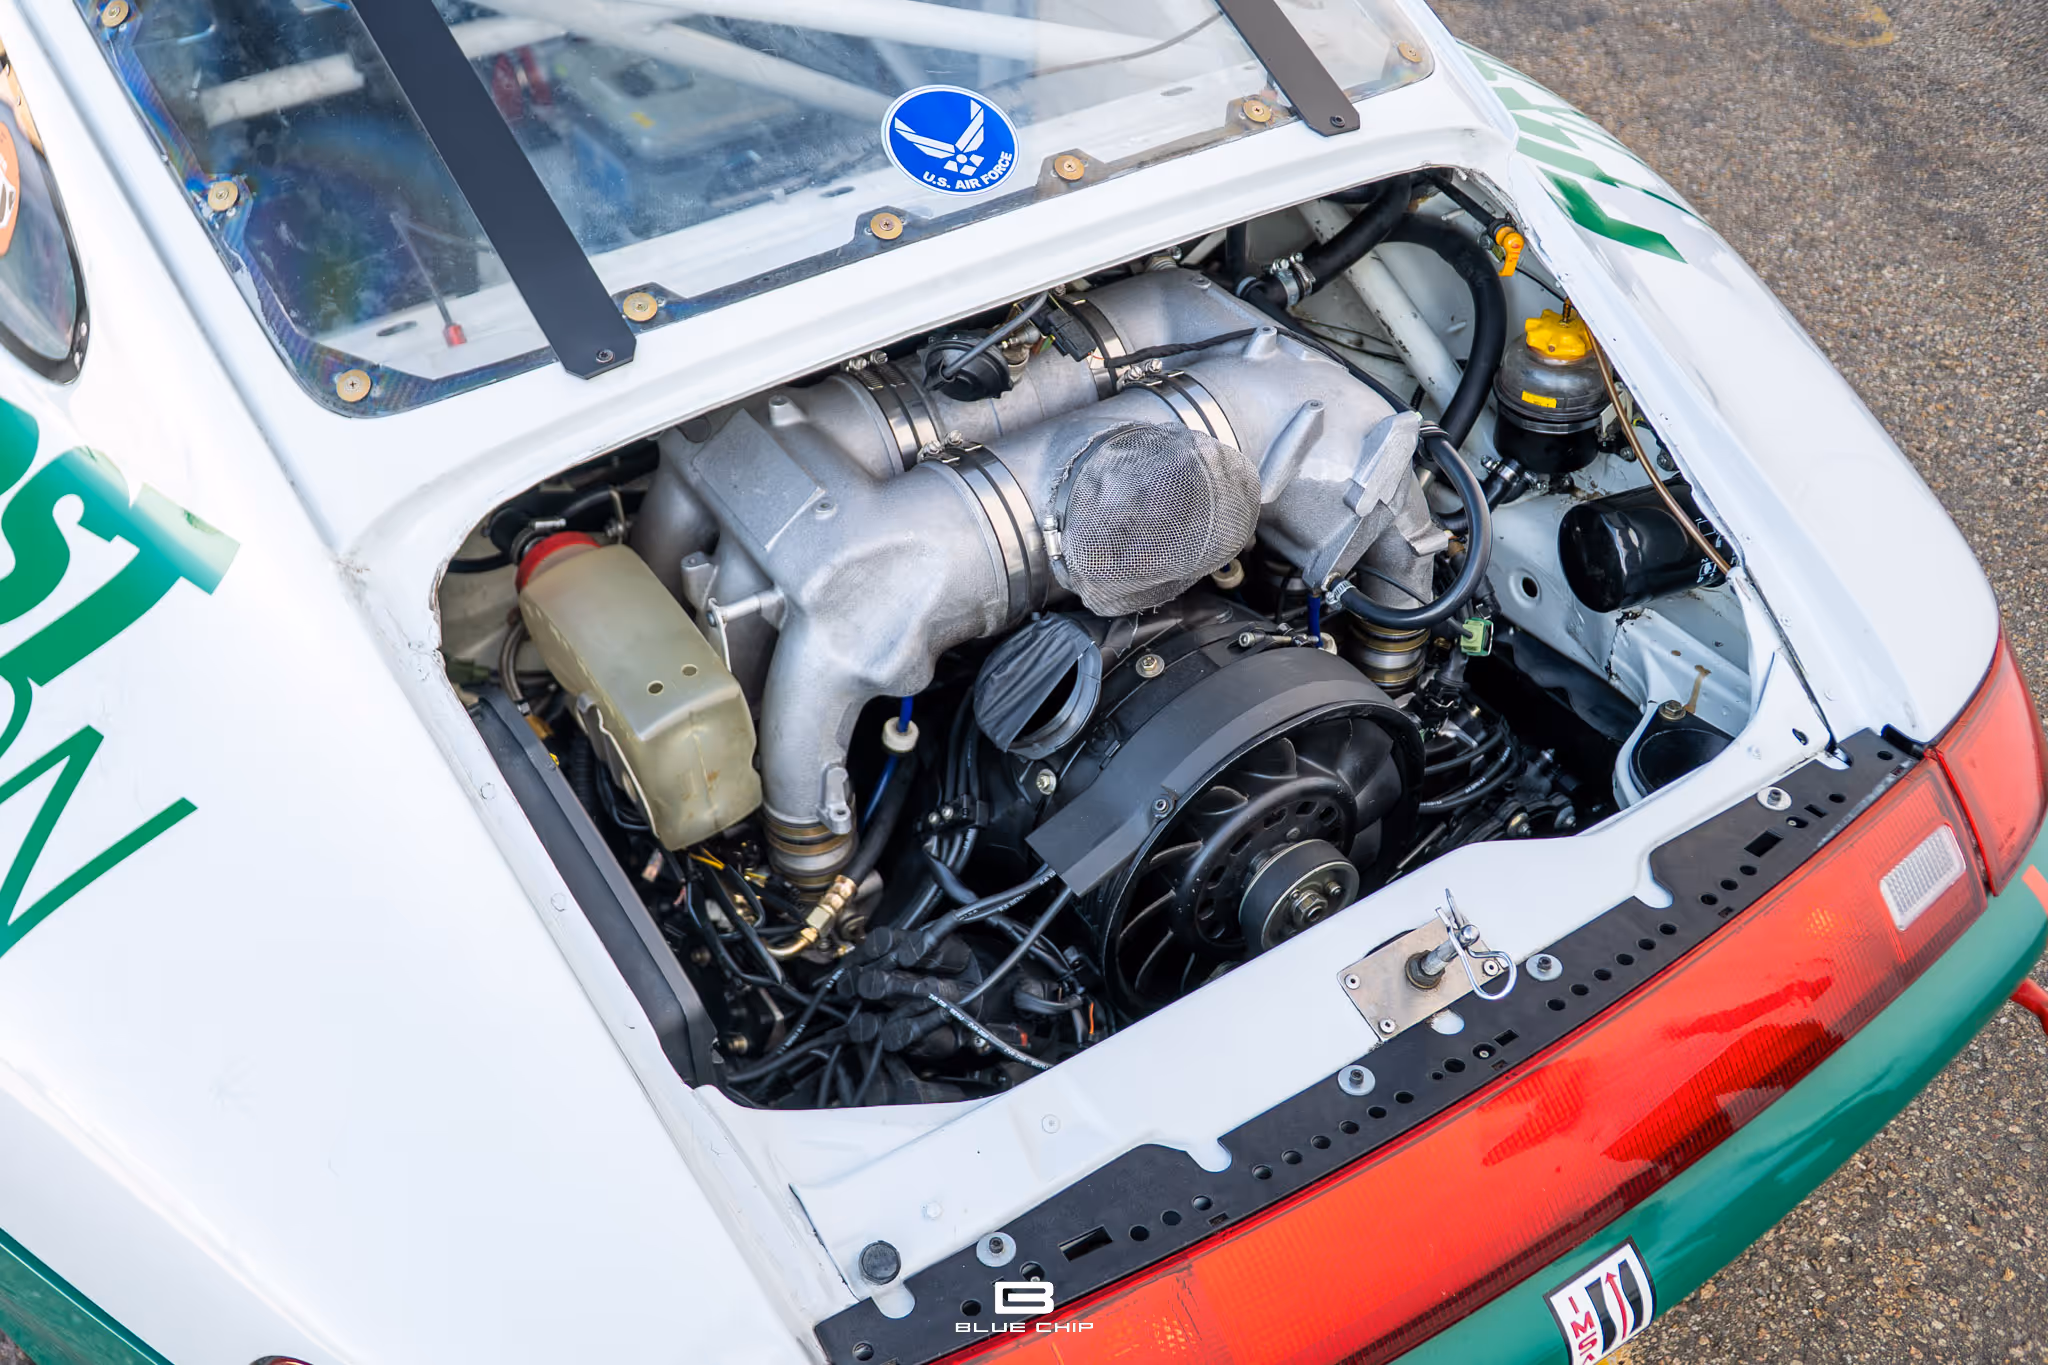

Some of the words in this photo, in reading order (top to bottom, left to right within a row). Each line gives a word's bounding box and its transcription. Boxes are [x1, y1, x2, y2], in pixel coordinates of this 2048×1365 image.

[922, 170, 951, 188] U.S.
[954, 178, 981, 190] AIR
[980, 151, 1012, 185] FORCE
